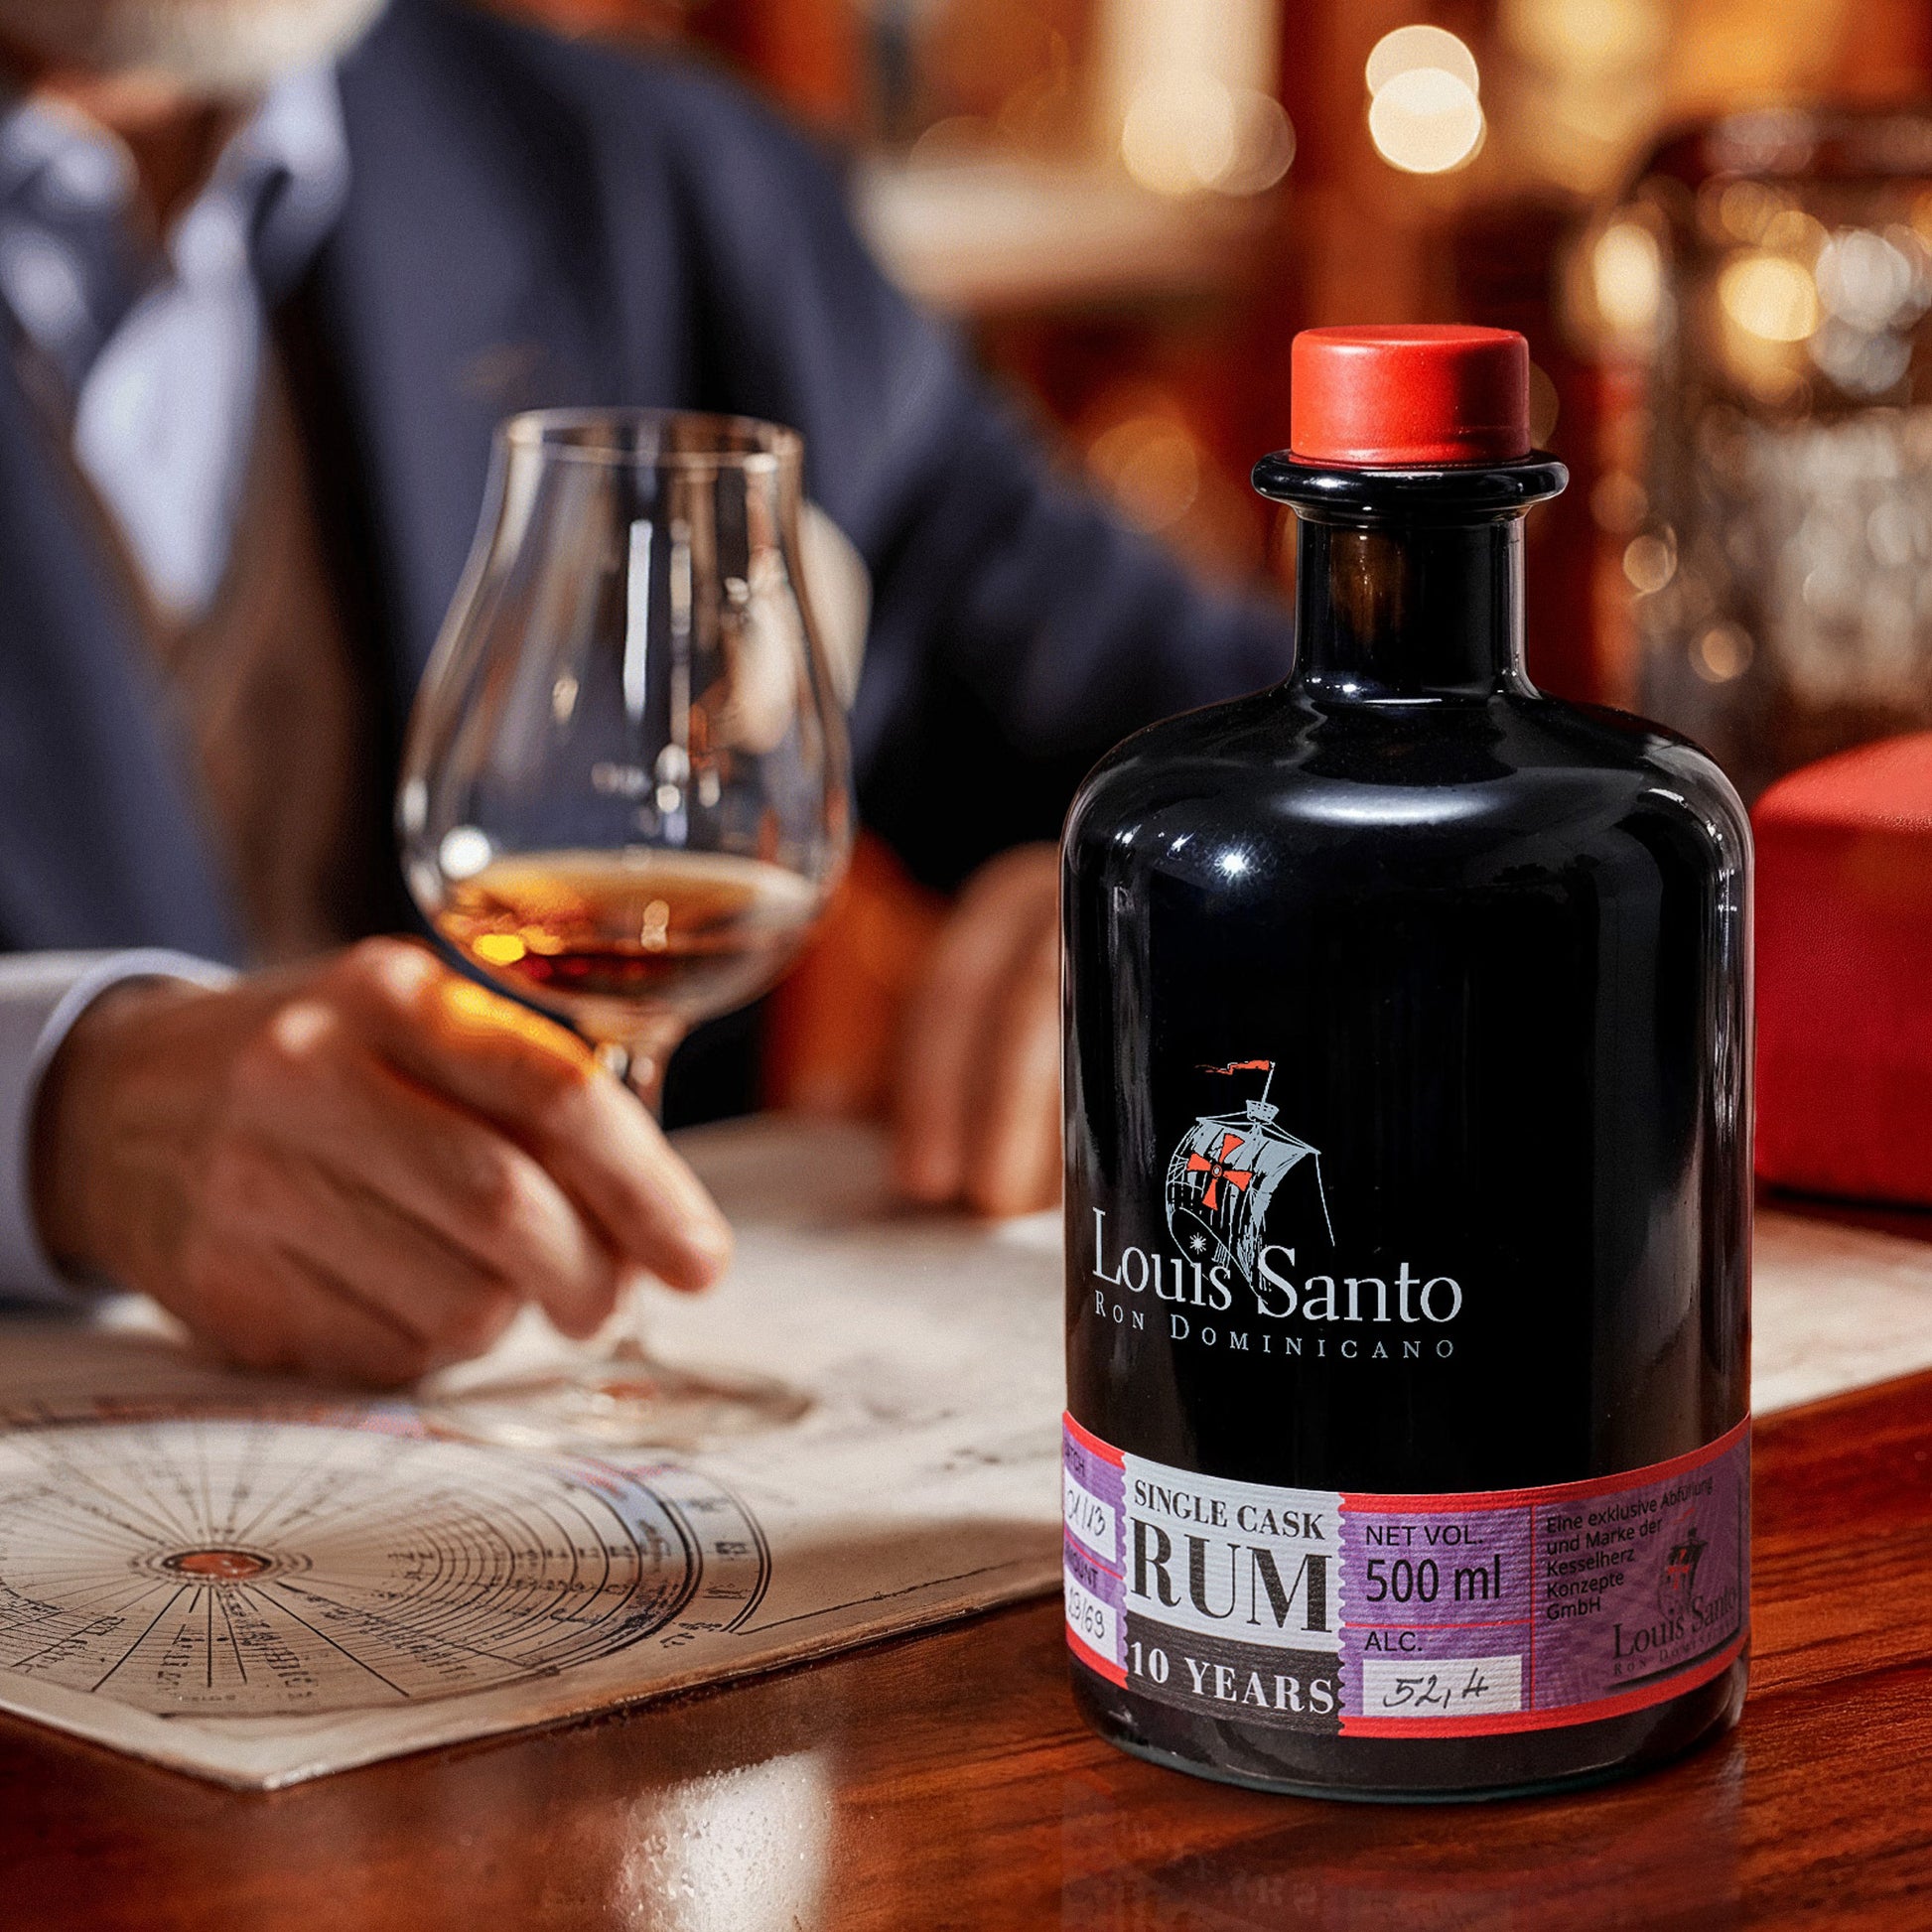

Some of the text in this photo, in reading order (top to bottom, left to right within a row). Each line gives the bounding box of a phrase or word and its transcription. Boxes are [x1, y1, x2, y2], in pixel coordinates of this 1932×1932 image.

[1092, 1207, 1462, 1323] Louis Santo
[1095, 1290, 1454, 1359] RON DOMINICANO
[1134, 1479, 1325, 1540] SINGLE CASK
[1547, 1515, 1583, 1534] Eine
[1588, 1499, 1662, 1526] exklusive
[1366, 1524, 1483, 1546] NET VOL.
[1547, 1517, 1663, 1556] und Marke der
[1130, 1516, 1332, 1633] RUM
[1366, 1554, 1501, 1603] 500 ml
[1547, 1547, 1636, 1578] Kesselherz
[1547, 1573, 1625, 1599] Konzepte
[1547, 1596, 1601, 1621] GmbH
[1364, 1630, 1423, 1652] ALC.
[1612, 1611, 1685, 1660] Louis
[1131, 1641, 1334, 1715] 10 YEARS
